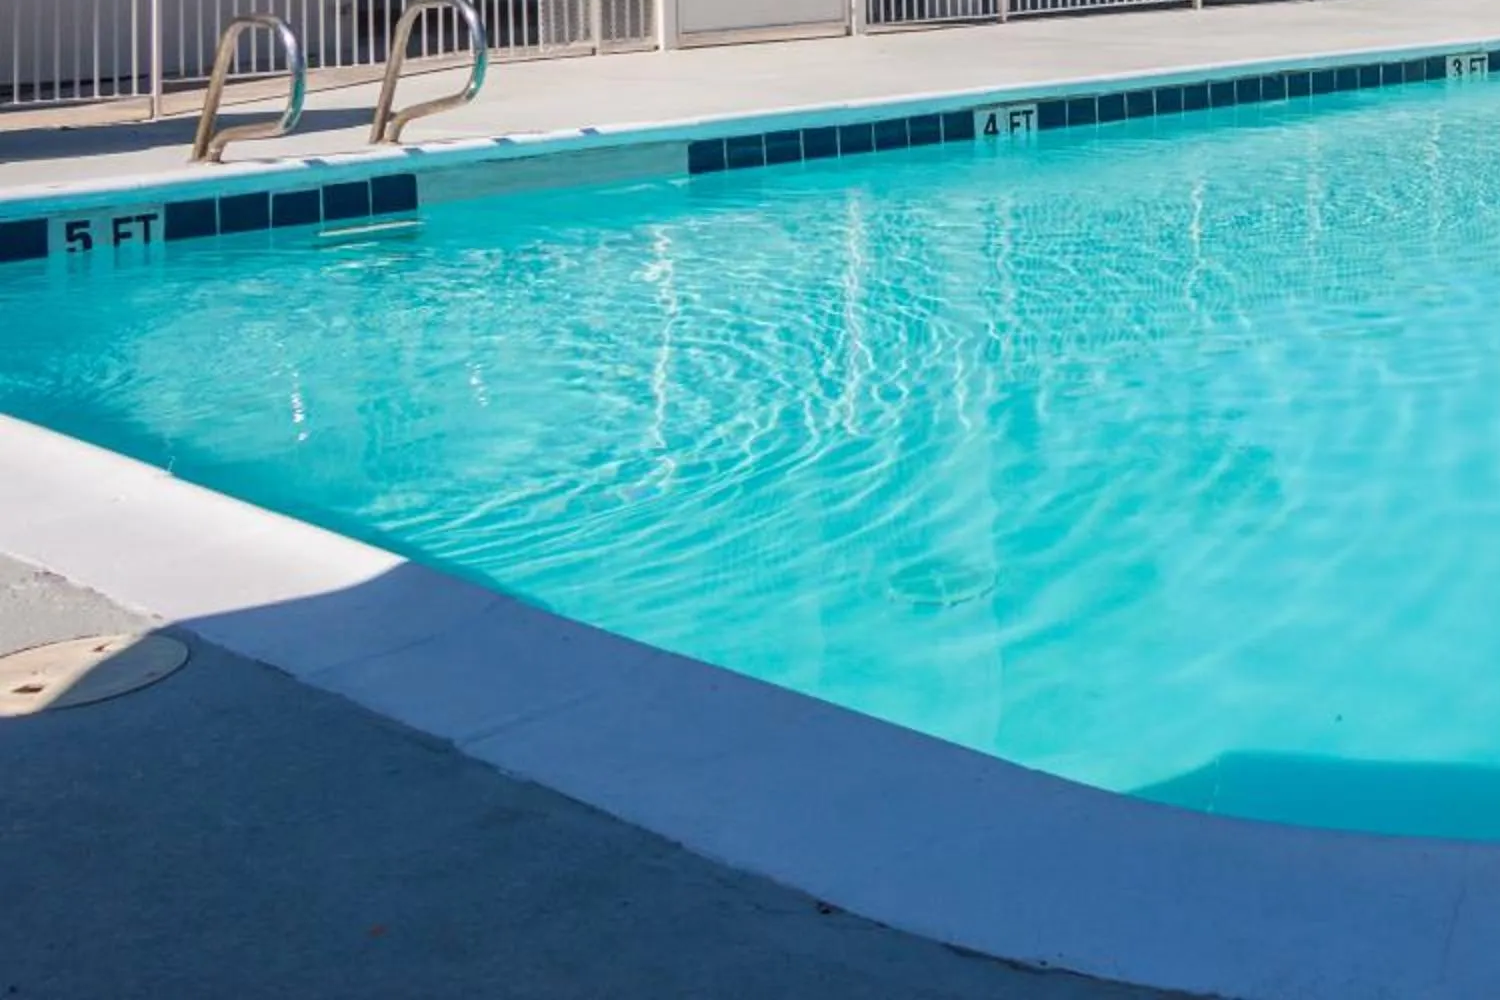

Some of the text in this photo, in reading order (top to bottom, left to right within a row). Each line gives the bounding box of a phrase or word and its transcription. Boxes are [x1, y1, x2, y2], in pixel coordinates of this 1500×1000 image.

[1452, 58, 1463, 77] 3
[983, 109, 1034, 135] 4 FT
[65, 212, 159, 252] 5 FT
